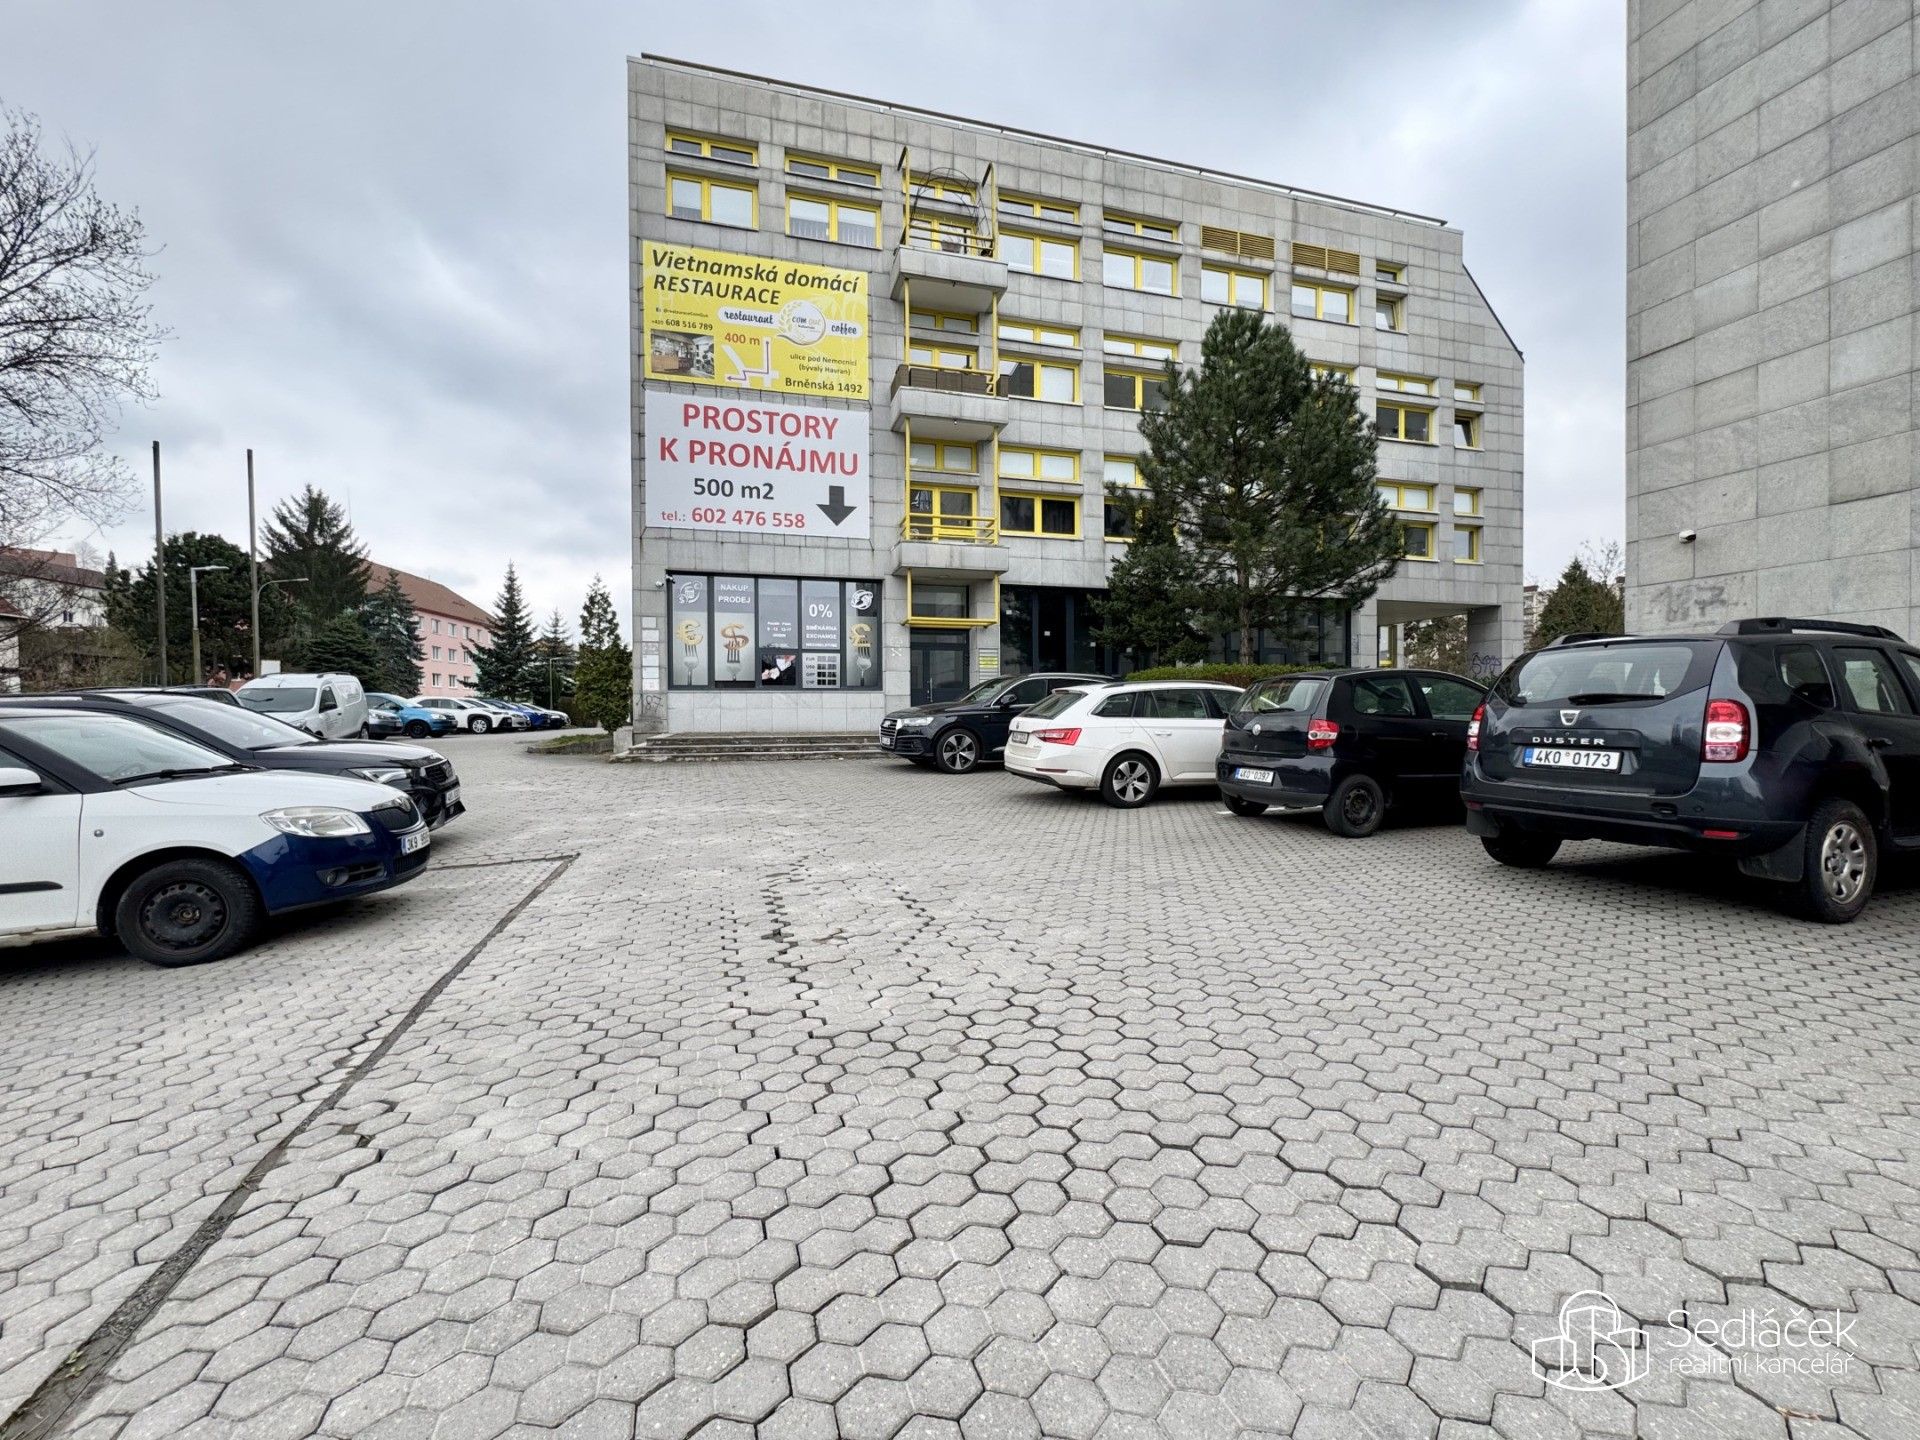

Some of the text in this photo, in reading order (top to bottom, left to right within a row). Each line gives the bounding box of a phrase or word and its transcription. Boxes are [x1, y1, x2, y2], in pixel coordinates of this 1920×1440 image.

[652, 249, 860, 294] Vietnamská domácí
[653, 274, 781, 305] RESTAURACE
[665, 318, 680, 327] 608
[682, 320, 697, 329] 516
[699, 322, 713, 331] 789
[723, 310, 775, 325] restaurant
[831, 322, 858, 337] coffee
[724, 332, 760, 346] 400 m
[790, 353, 806, 361] ulice
[808, 355, 821, 363] pod
[824, 366, 851, 376] Havran)
[785, 377, 863, 394] Brněnská 1492
[683, 403, 839, 440] PROSTORY
[659, 437, 859, 476] K PRONÁJMU
[693, 478, 775, 500] 500 m2
[661, 507, 805, 529] tel.: 602 476 558
[718, 595, 751, 604] PRODEJ
[809, 603, 833, 619] 0%
[1532, 736, 1606, 746] DUSTER
[1572, 752, 1611, 767] 0173
